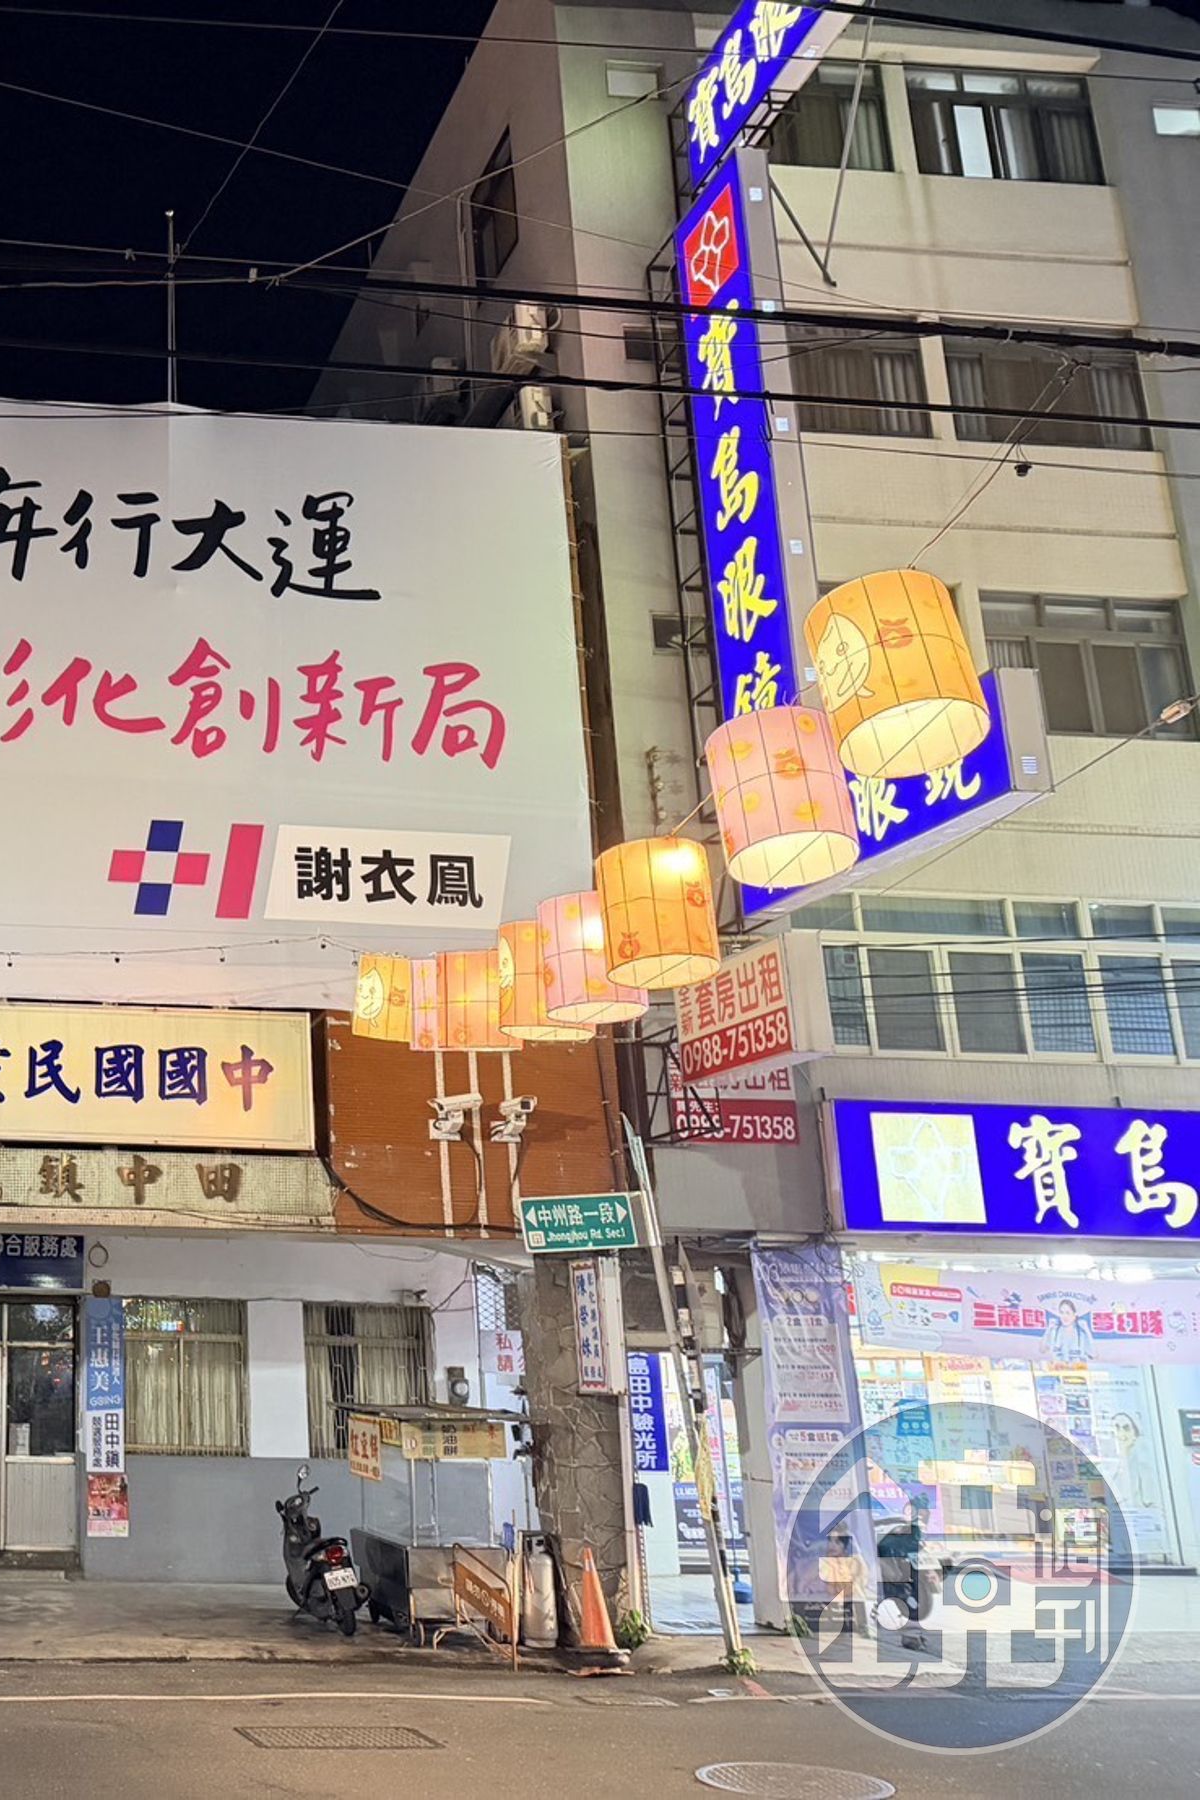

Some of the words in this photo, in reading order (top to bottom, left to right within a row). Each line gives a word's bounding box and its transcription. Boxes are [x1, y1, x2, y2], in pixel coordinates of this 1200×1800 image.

[293, 845, 485, 910] 謝衣鳳
[678, 984, 694, 1037] 全新
[695, 951, 784, 1031] 套房出租
[682, 1010, 790, 1076] 0988-751358
[1006, 1113, 1199, 1229] 寶島
[537, 1202, 615, 1228] 中州路一段
[105, 1413, 120, 1468] 田中鎮
[627, 1352, 658, 1470] 島田中驗光所
